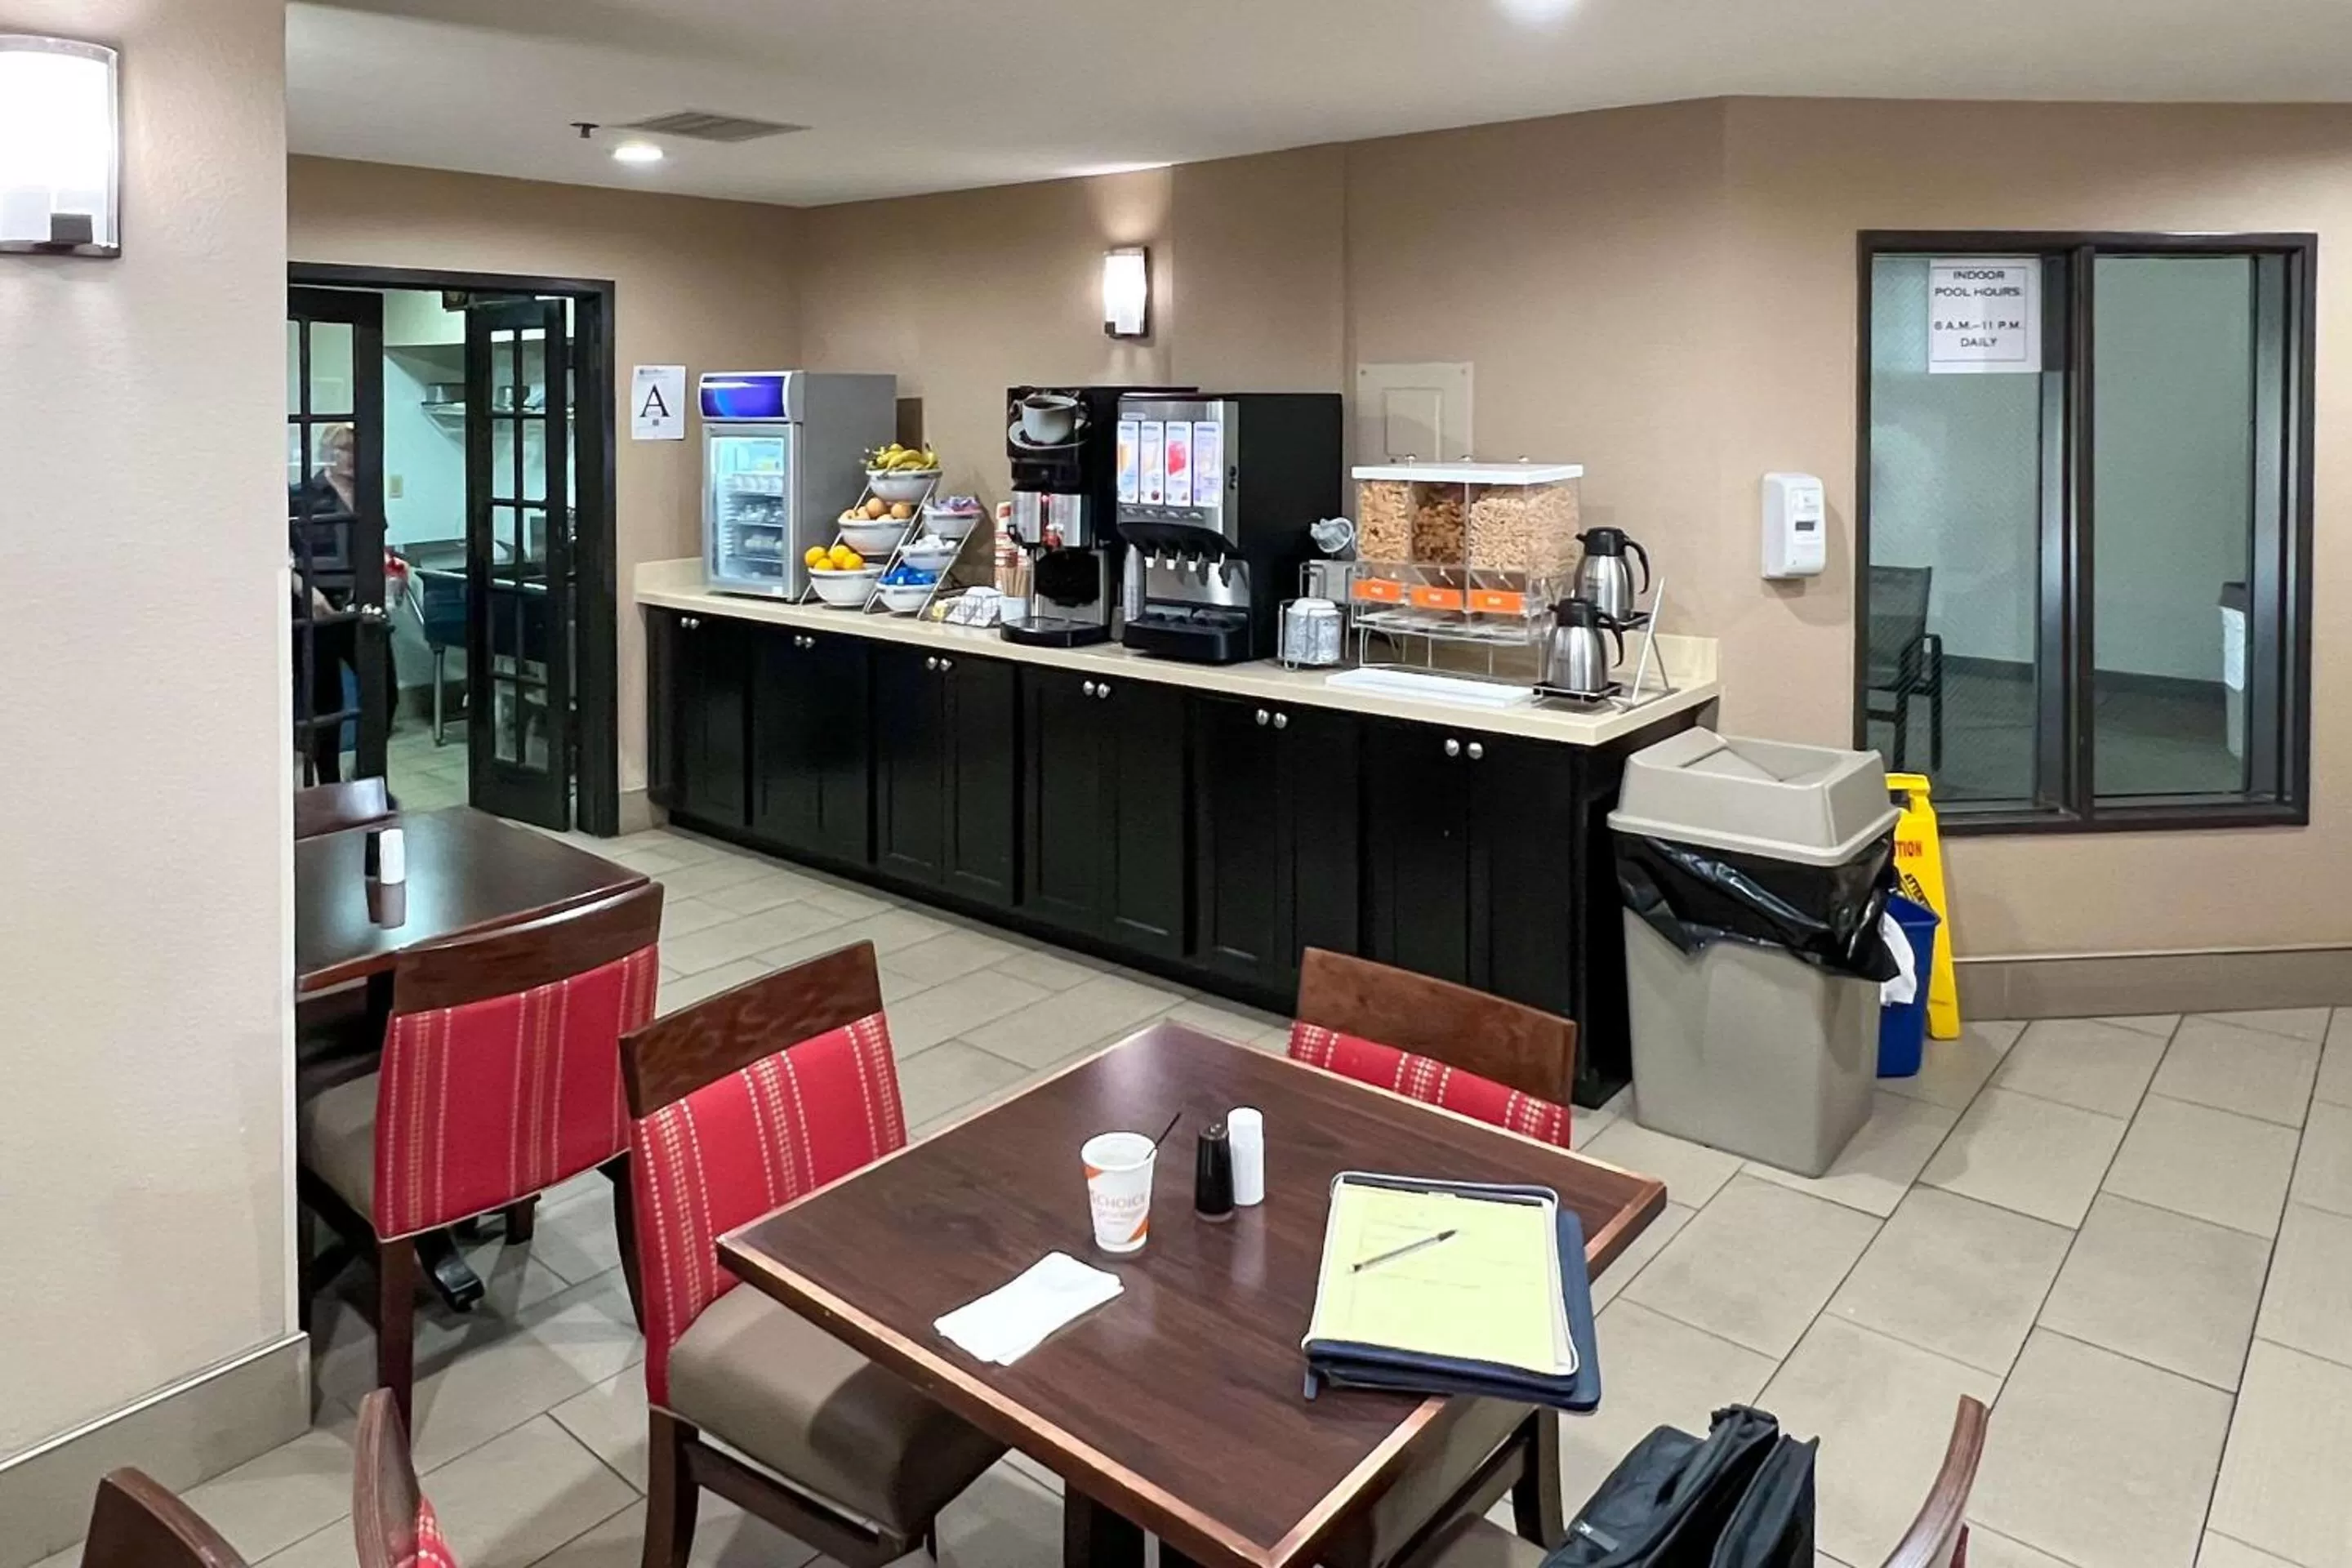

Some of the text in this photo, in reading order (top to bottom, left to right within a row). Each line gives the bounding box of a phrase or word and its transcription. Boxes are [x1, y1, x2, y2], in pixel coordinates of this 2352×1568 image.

[1953, 270, 2005, 280] INDOOR
[1935, 287, 1971, 296] POOL
[1960, 337, 1998, 347] DAILY
[639, 384, 670, 417] A
